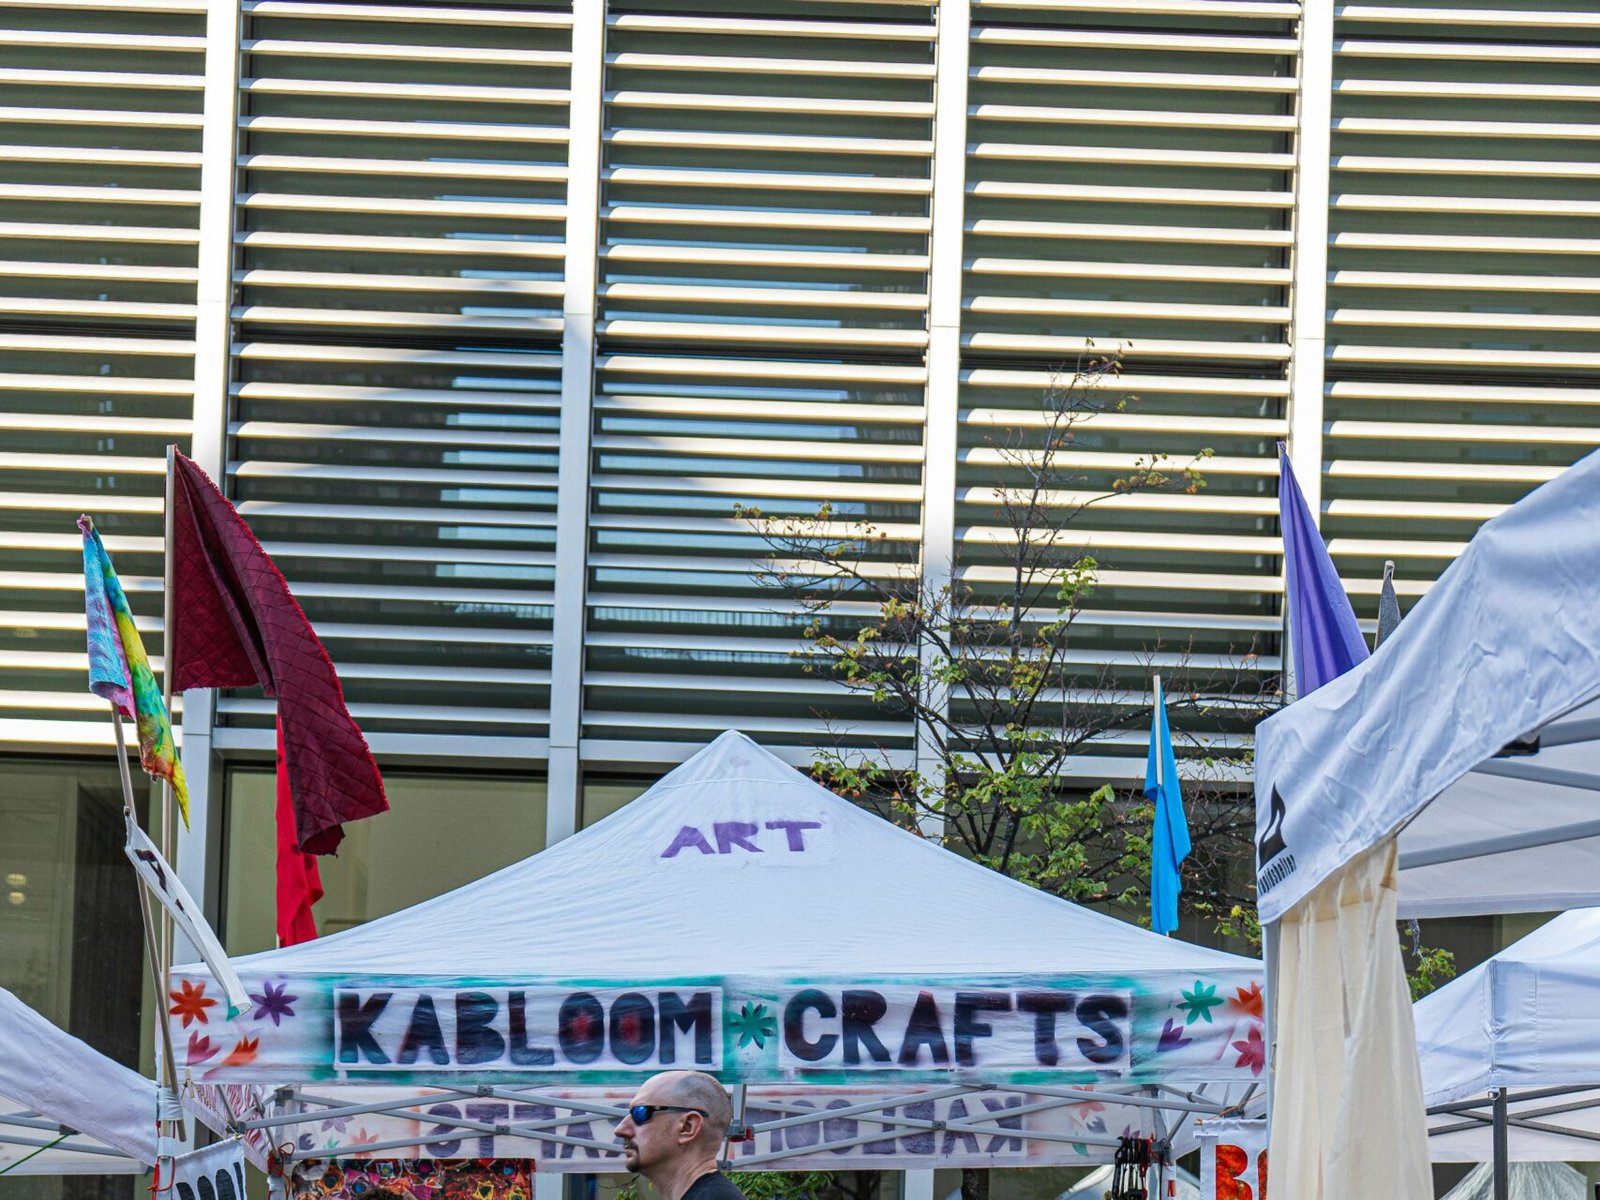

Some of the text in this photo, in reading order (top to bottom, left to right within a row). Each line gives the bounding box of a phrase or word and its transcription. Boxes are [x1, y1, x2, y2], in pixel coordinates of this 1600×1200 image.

[661, 821, 822, 858] ART
[339, 989, 1129, 1067] KABLOOM CRAFTS
